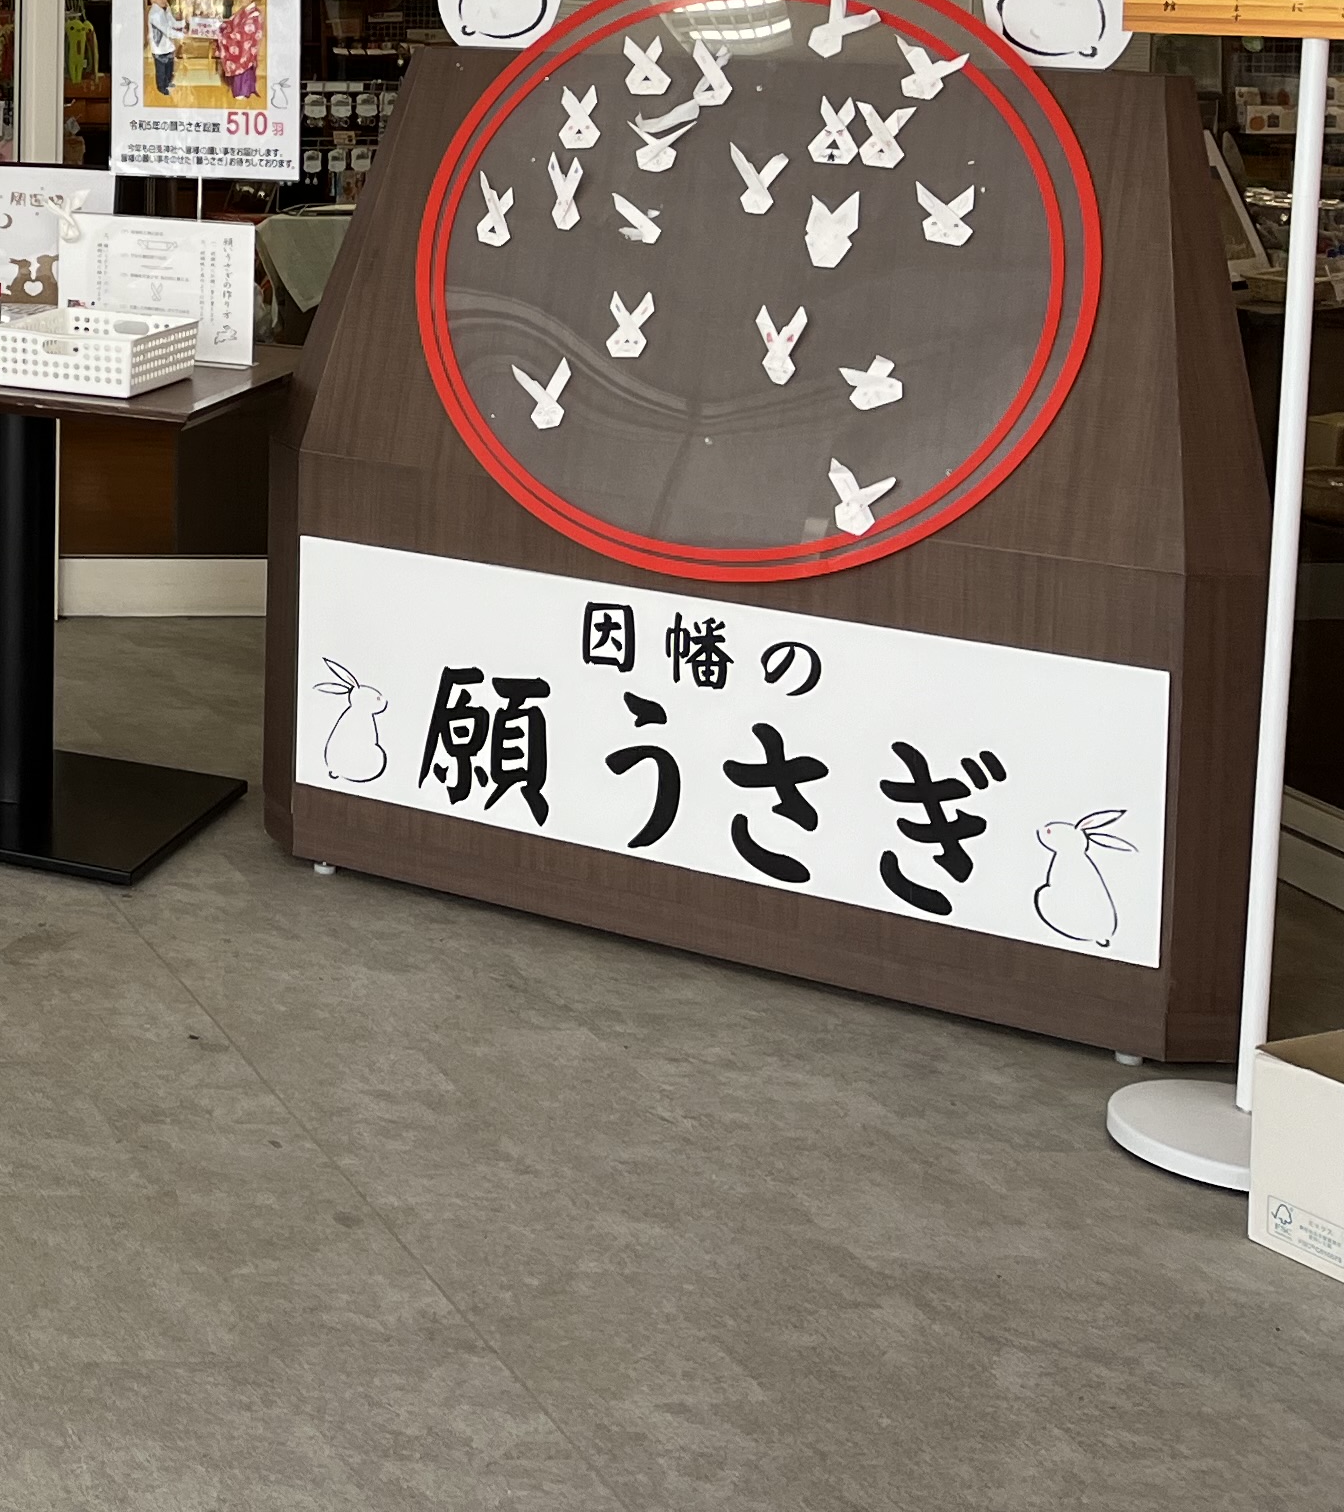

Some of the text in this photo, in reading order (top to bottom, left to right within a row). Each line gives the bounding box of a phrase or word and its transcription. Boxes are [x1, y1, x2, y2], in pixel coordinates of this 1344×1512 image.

[226, 111, 269, 136] 510
[271, 121, 285, 136] 羽
[581, 600, 823, 697] 因幡の
[417, 666, 1010, 917] 願うさぎ
